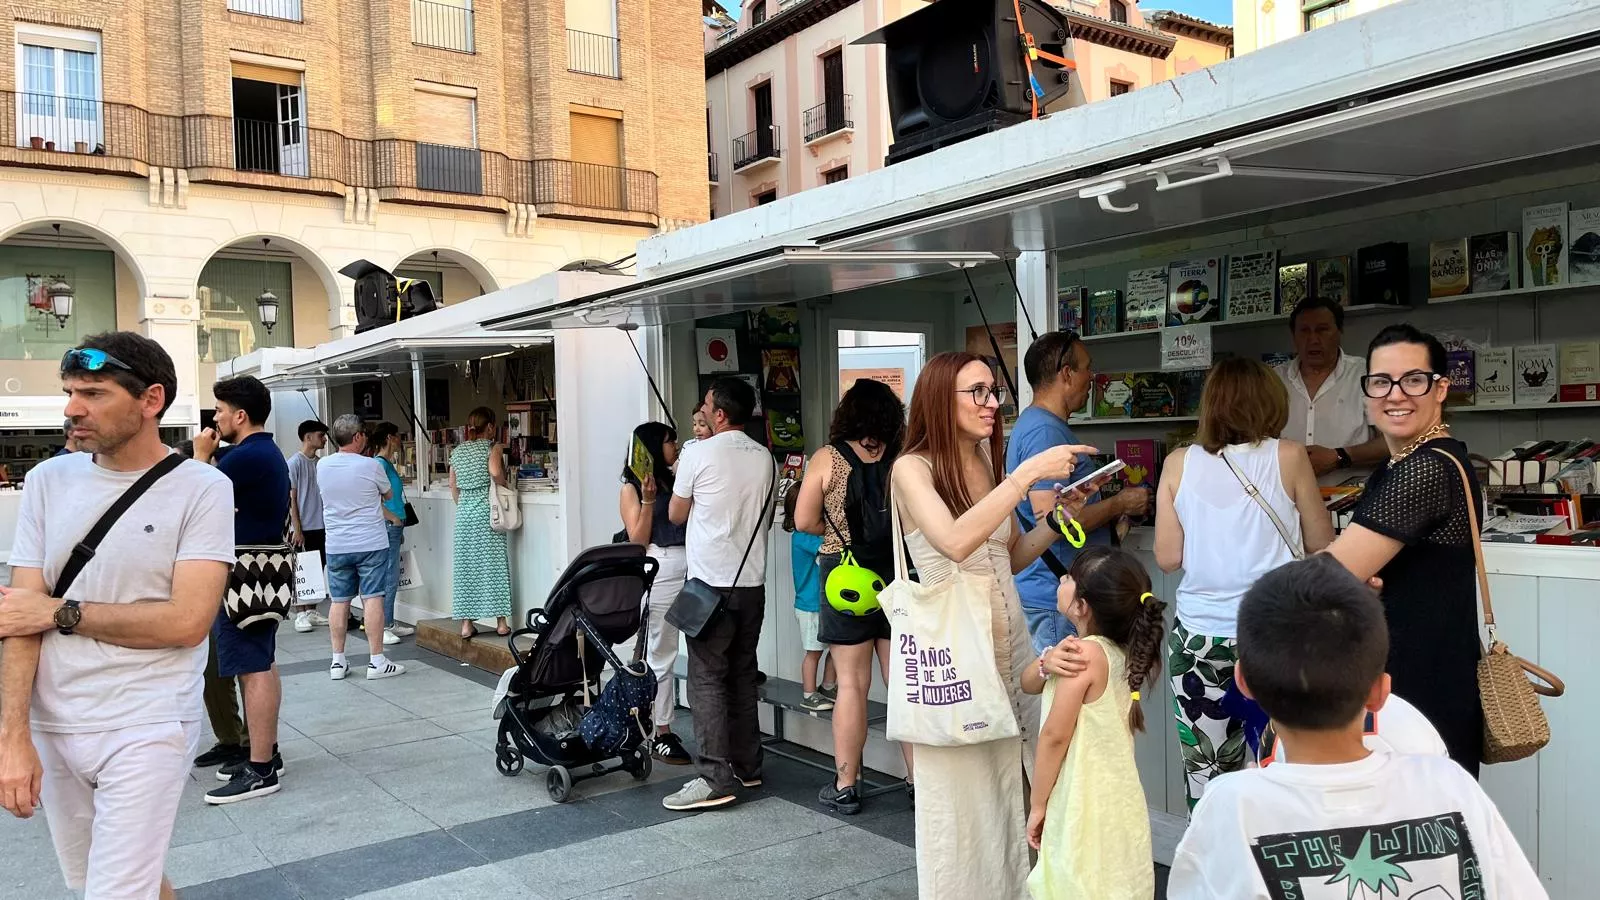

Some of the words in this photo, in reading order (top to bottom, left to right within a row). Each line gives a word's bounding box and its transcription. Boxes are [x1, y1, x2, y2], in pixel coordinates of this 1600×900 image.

[1474, 250, 1496, 259] ALAS
[1432, 257, 1455, 267] ALAS
[1180, 268, 1208, 277] TIERRA
[1431, 266, 1465, 279] SANGRE
[1174, 334, 1197, 347] 10%
[1517, 358, 1554, 370] ROMA
[1476, 383, 1510, 393] Nexus
[398, 578, 412, 586] ESCA
[297, 588, 316, 597] ESCA
[899, 633, 917, 656] 25
[920, 647, 952, 668] AÑOS
[905, 658, 919, 687] LADO
[924, 669, 935, 683] DE
[942, 667, 957, 682] LAS
[906, 688, 920, 704] AL
[923, 682, 971, 704] MUJERES
[1261, 834, 1343, 869] THE
